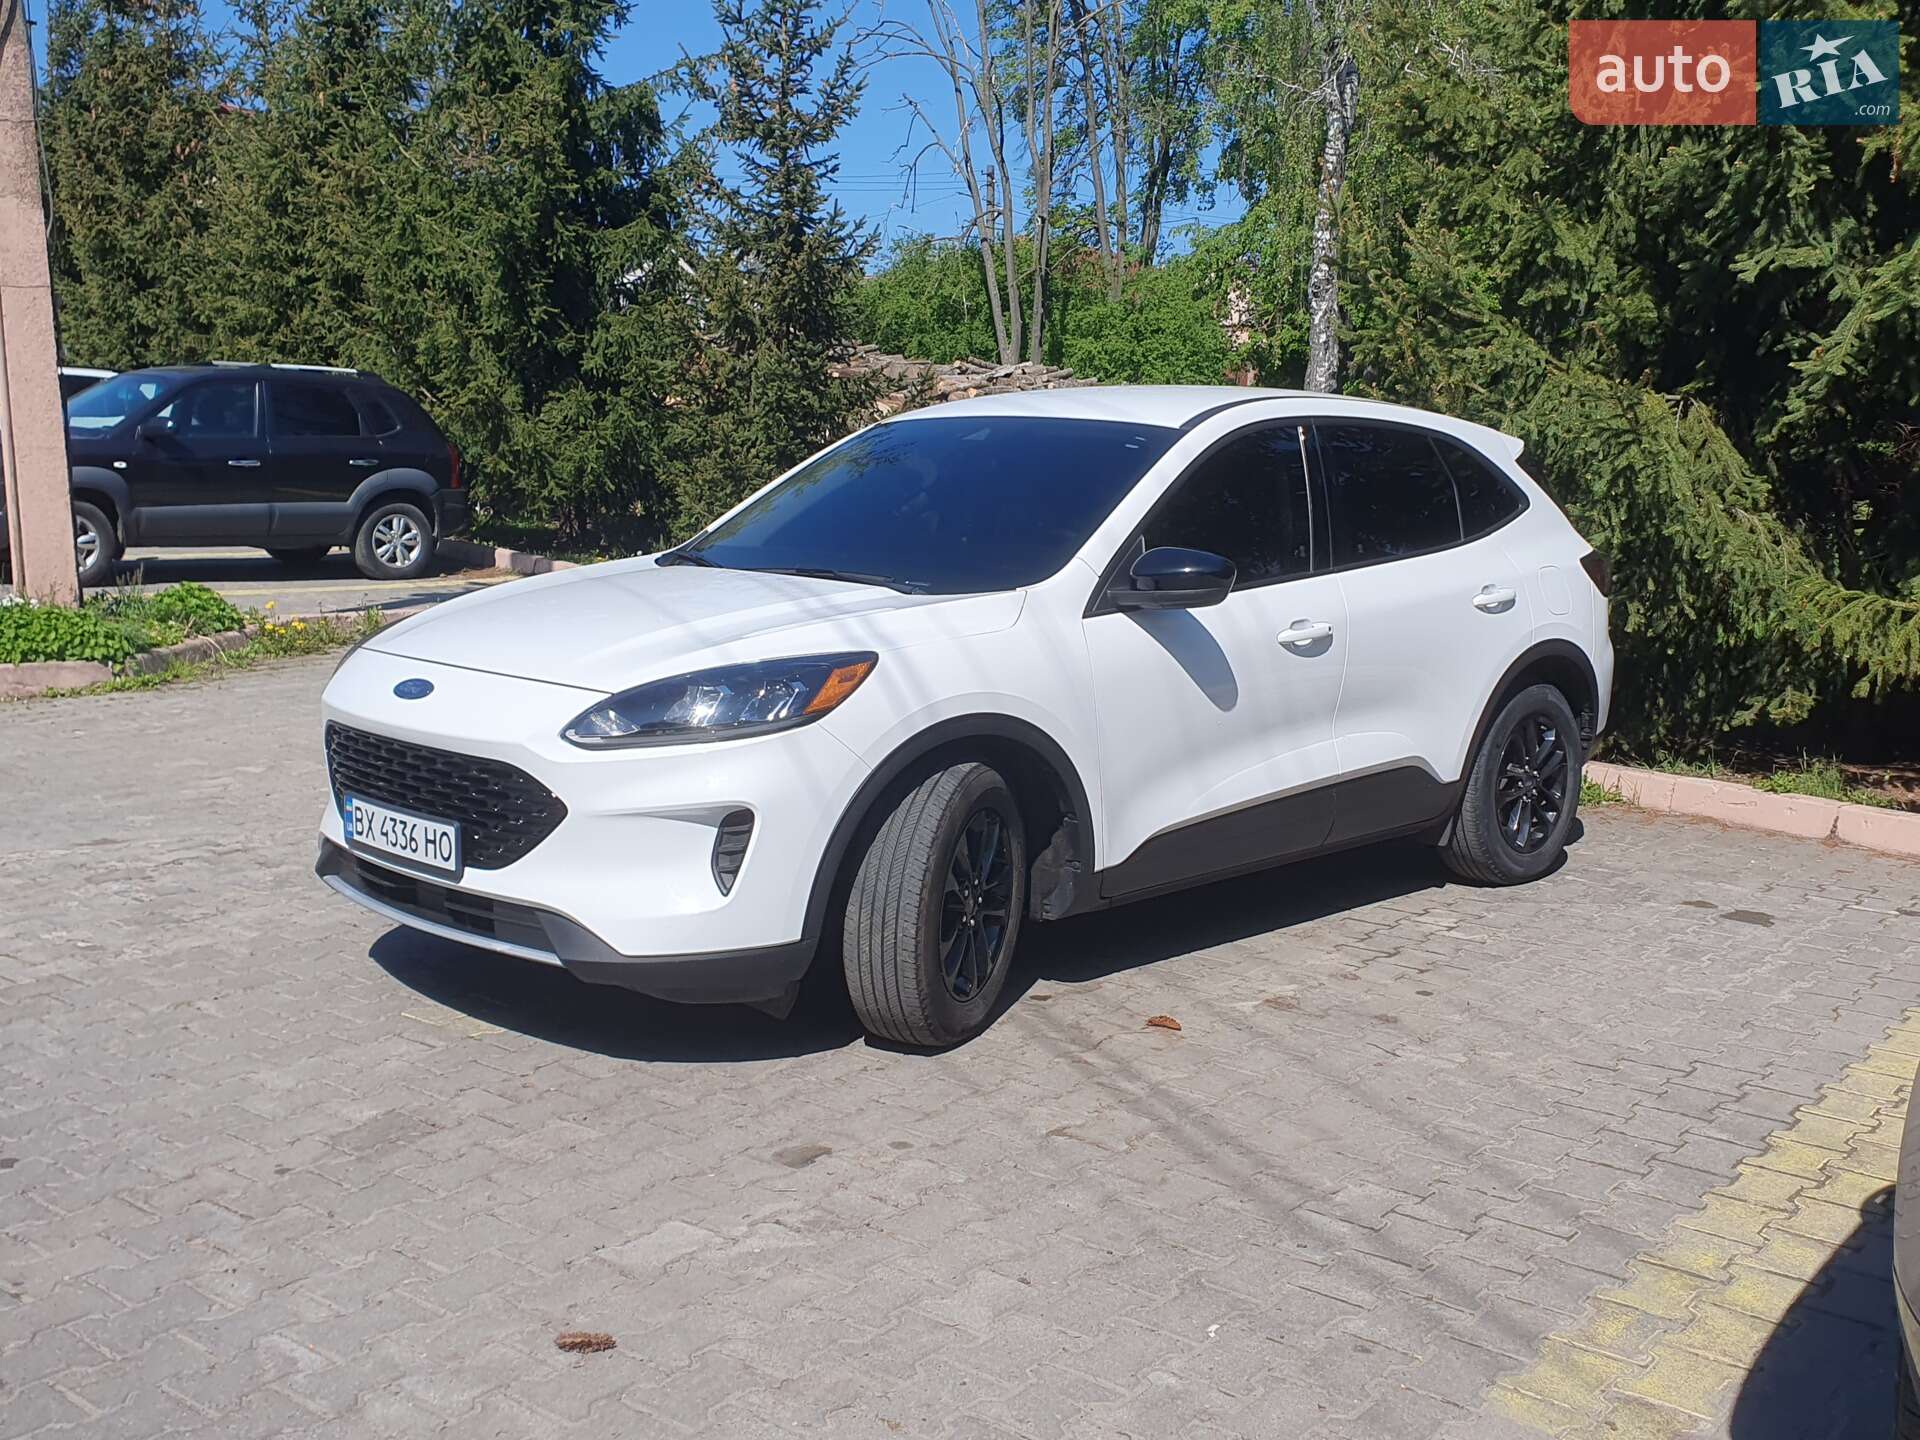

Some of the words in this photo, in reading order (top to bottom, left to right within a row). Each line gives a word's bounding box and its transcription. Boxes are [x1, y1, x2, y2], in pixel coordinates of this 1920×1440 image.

[354, 806, 376, 842] BX
[380, 815, 419, 853] 4336
[424, 826, 453, 863] HO
